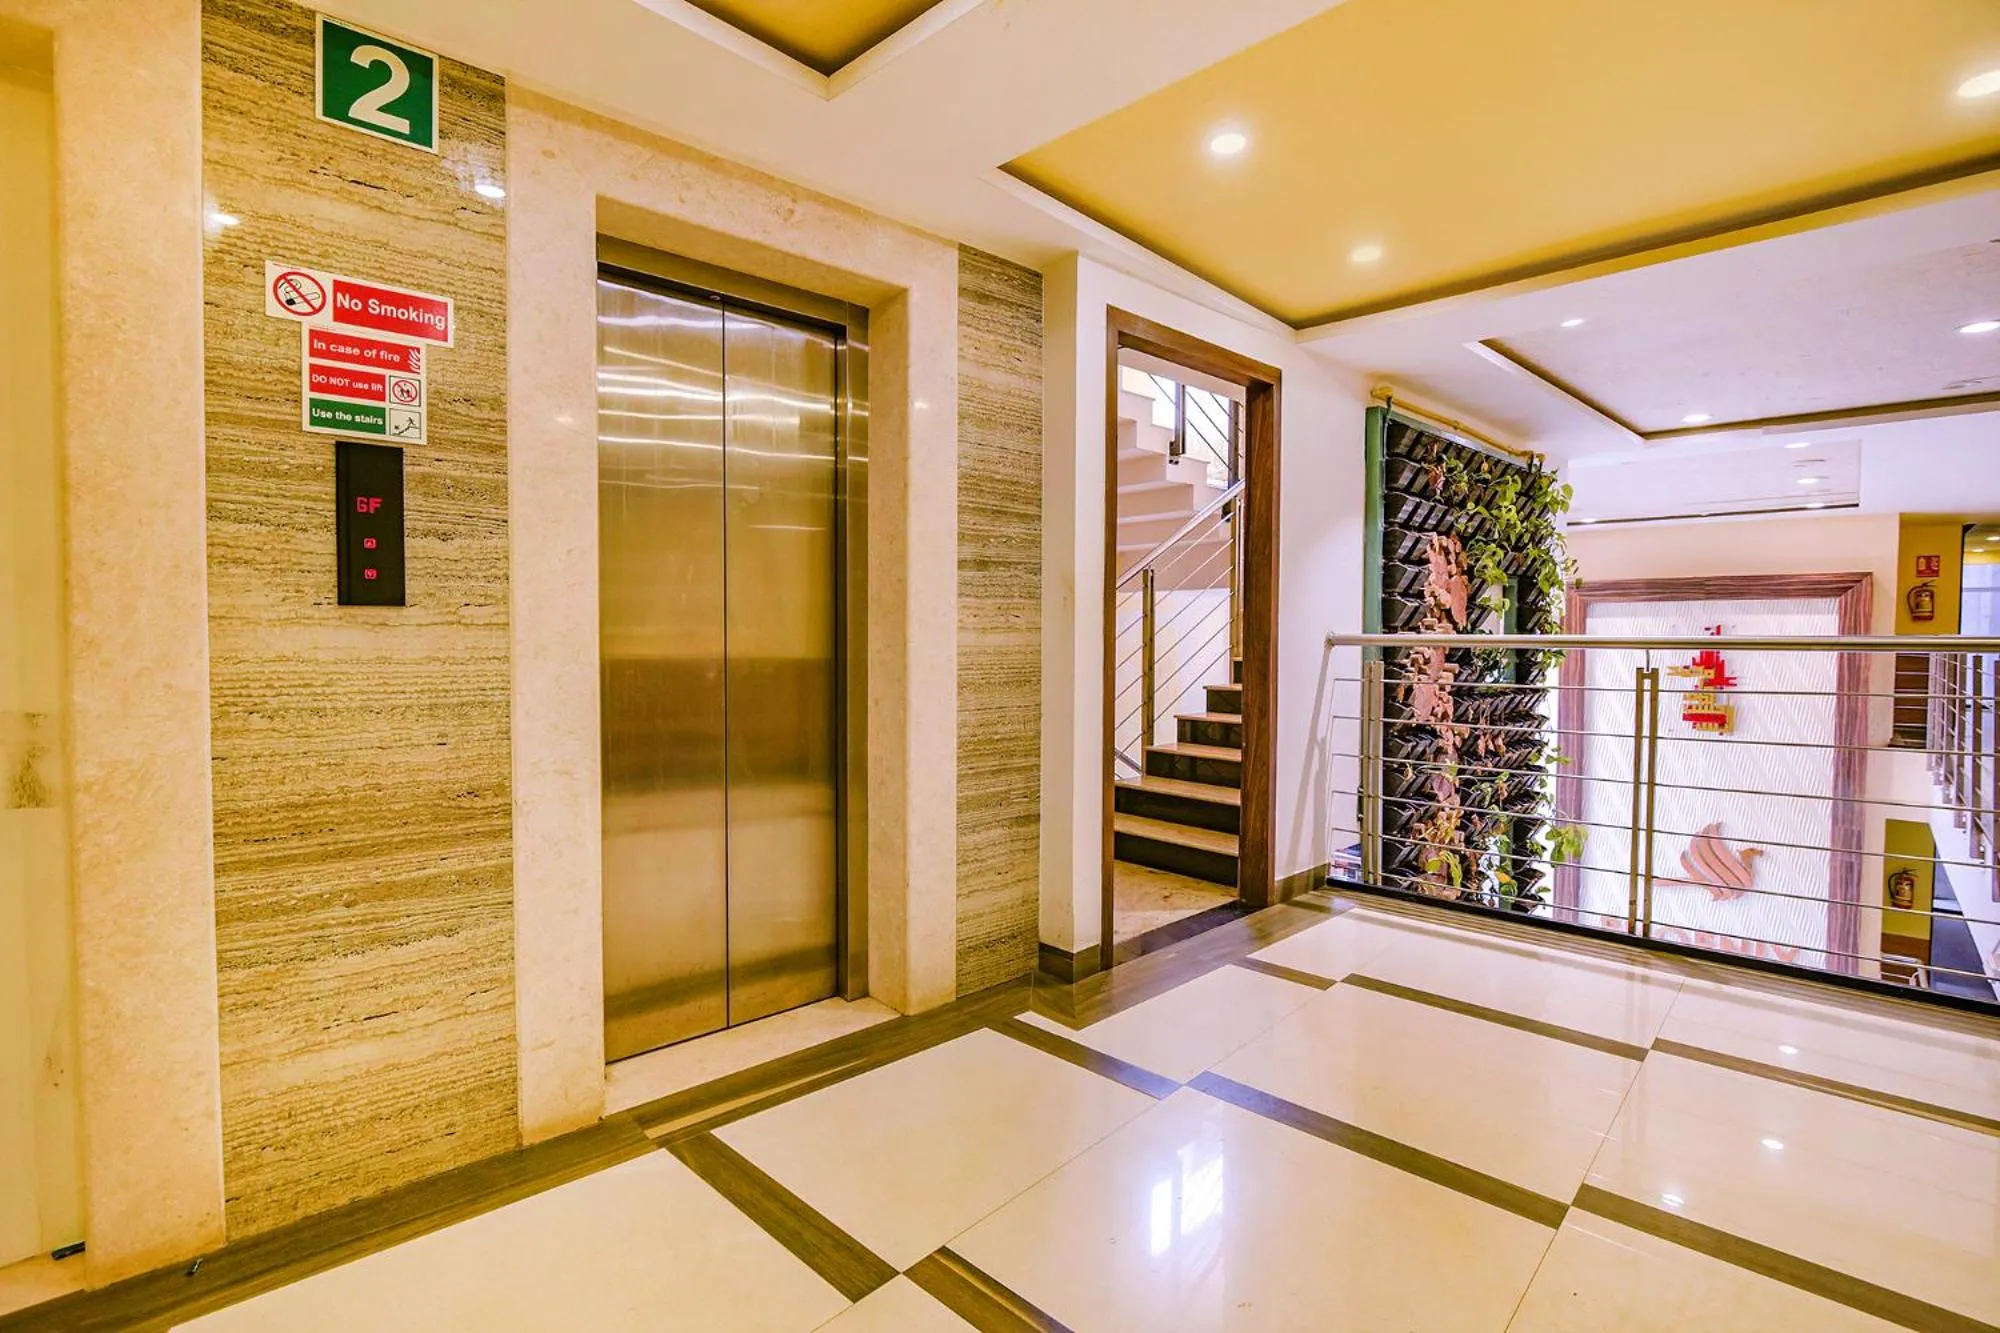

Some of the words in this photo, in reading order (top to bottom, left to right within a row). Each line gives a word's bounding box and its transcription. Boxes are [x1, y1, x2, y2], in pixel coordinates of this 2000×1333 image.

[348, 44, 410, 135] 2
[336, 292, 363, 311] No
[368, 298, 447, 331] Smoking
[313, 339, 326, 351] In
[330, 344, 360, 356] case
[364, 348, 377, 358] of
[380, 349, 401, 362] fire
[312, 374, 326, 384] DO
[330, 376, 350, 388] NOT
[352, 380, 369, 390] use
[371, 382, 384, 393] lift
[312, 407, 333, 420] Use
[335, 411, 352, 422] the
[355, 413, 384, 426] stairs
[356, 496, 383, 514] GF
